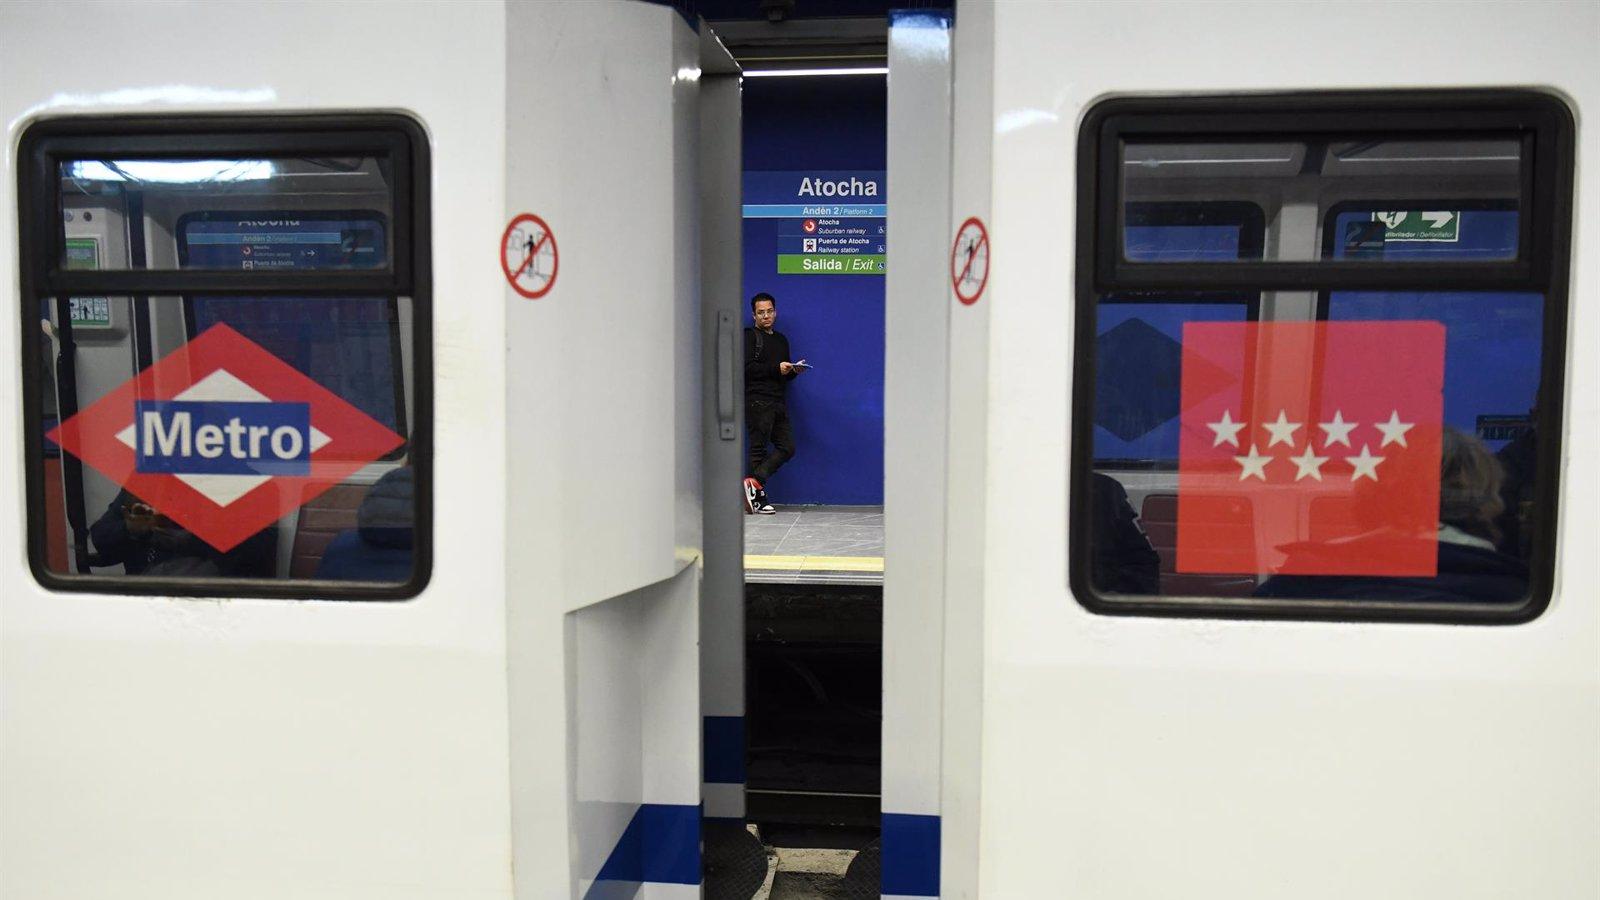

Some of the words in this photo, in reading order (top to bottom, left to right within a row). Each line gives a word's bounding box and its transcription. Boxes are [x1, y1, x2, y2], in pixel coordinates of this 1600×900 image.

[798, 177, 877, 196] Atocha
[803, 259, 842, 270] Salida
[852, 258, 874, 270] Exit
[143, 411, 304, 460] Metro
